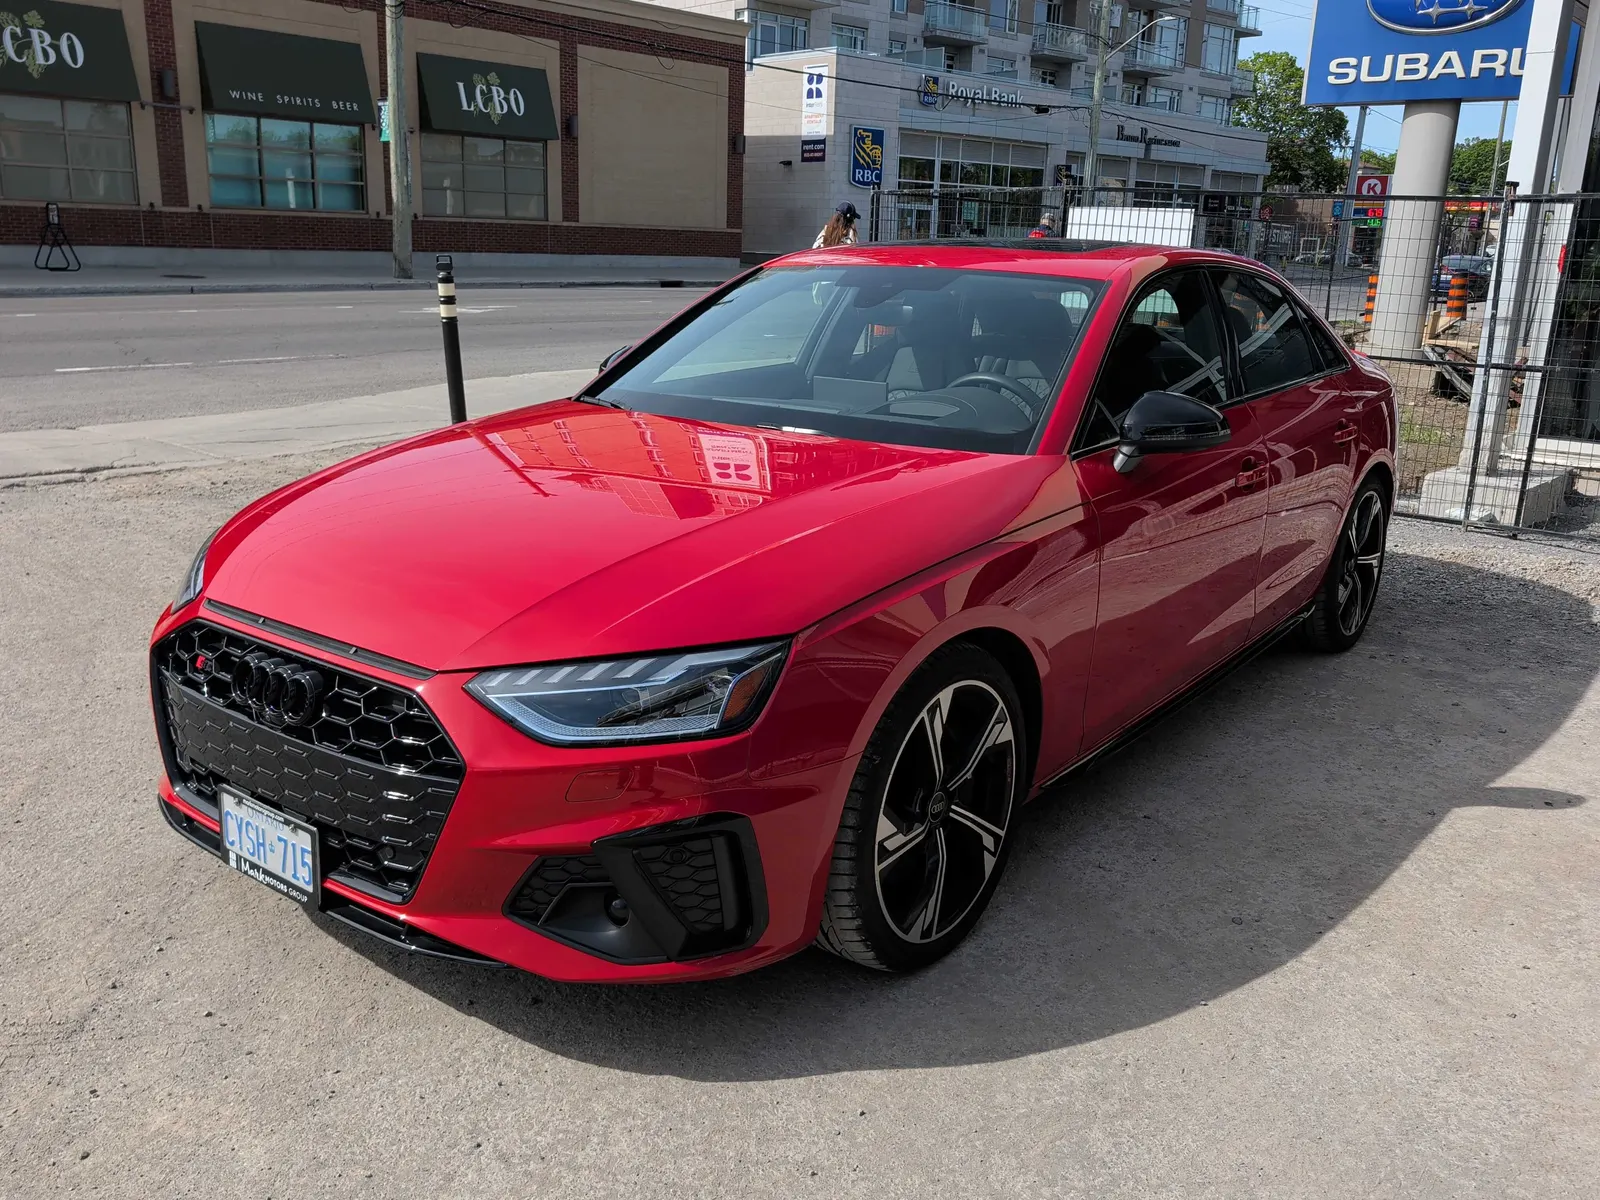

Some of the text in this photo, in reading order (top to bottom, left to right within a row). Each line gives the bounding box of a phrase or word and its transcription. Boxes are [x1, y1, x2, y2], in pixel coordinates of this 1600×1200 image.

[2, 25, 84, 68] CBO
[229, 89, 359, 111] WINE SPIRITS BEER
[456, 81, 525, 117] LCBO
[949, 81, 1024, 108] Royal Bank
[855, 168, 881, 183] RBC
[1366, 182, 1379, 196] K
[224, 809, 312, 886] CYSH 715
[241, 857, 308, 903] Mark MOTORS GROUP
